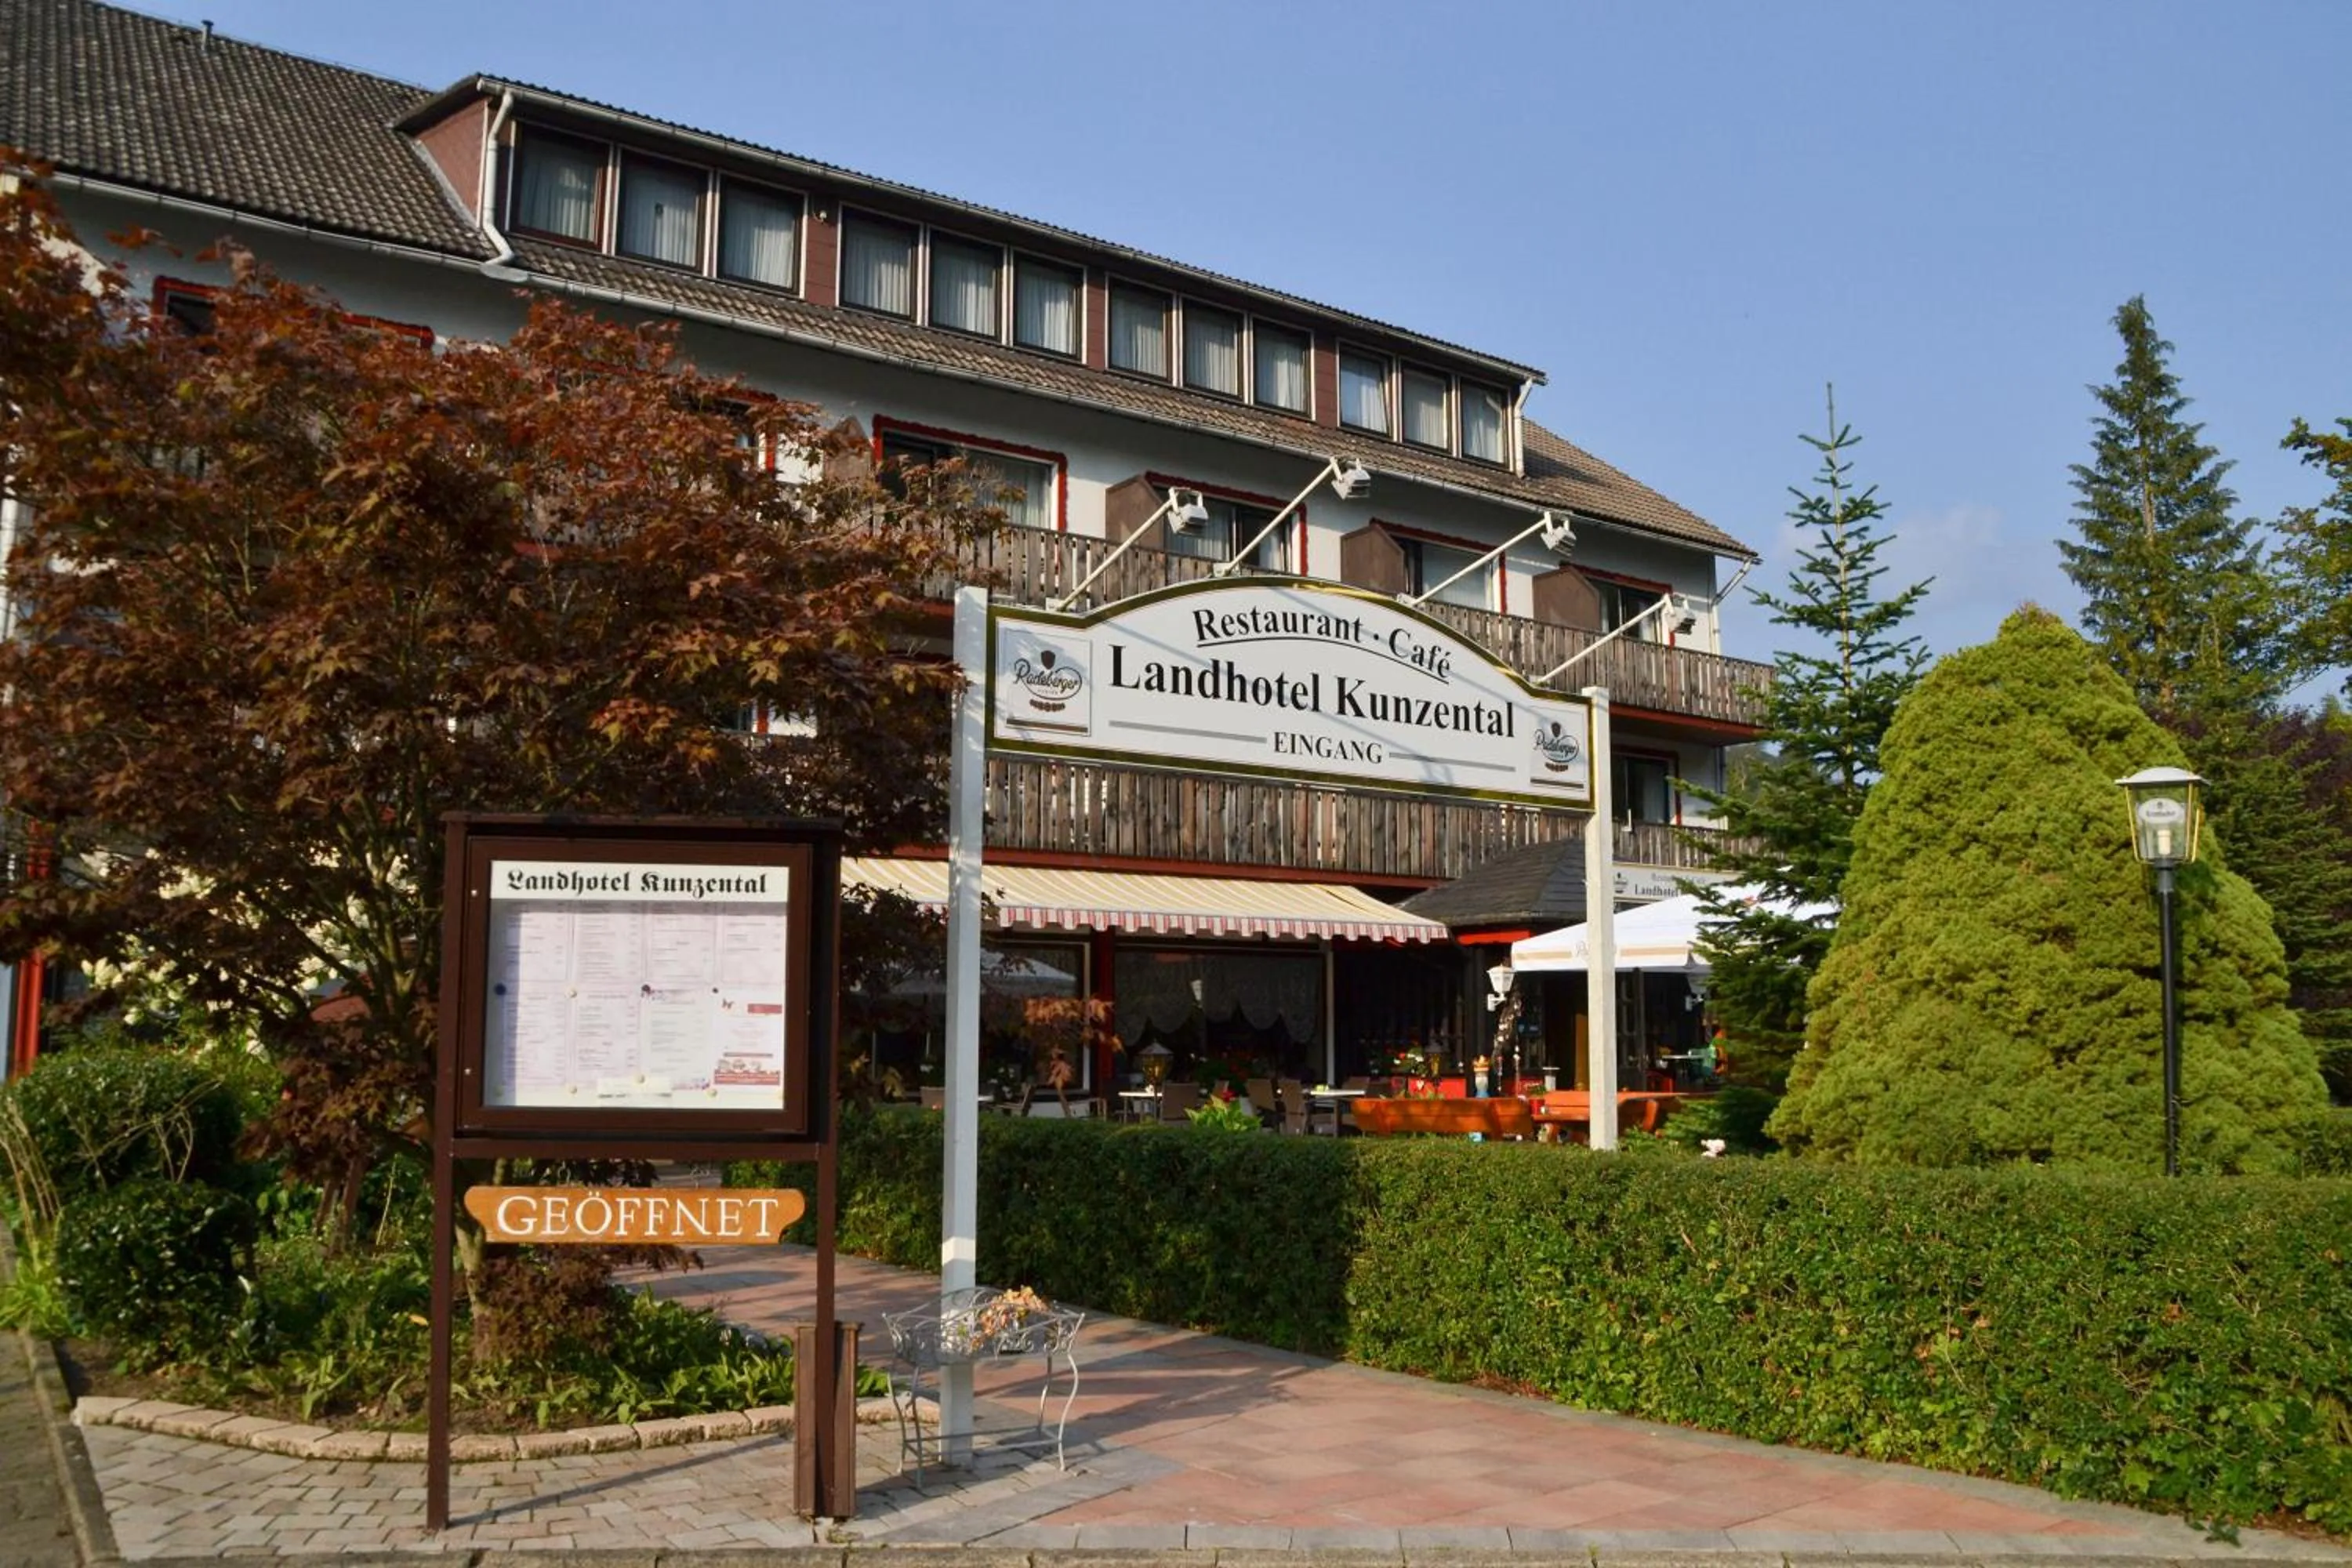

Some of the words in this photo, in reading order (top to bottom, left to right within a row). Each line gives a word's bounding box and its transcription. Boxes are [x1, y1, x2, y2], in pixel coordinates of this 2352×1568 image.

[1192, 608, 1363, 643] Restaurant
[1388, 628, 1451, 679] Café
[1014, 659, 1078, 693] Radeberger
[1109, 644, 1320, 712] Landhotel
[1336, 677, 1515, 738] Kunzental
[1273, 731, 1383, 764] EINGANG
[508, 870, 630, 895] Landhotel
[641, 872, 767, 898] Kunzental
[497, 1192, 779, 1236] GEÖFFNET
